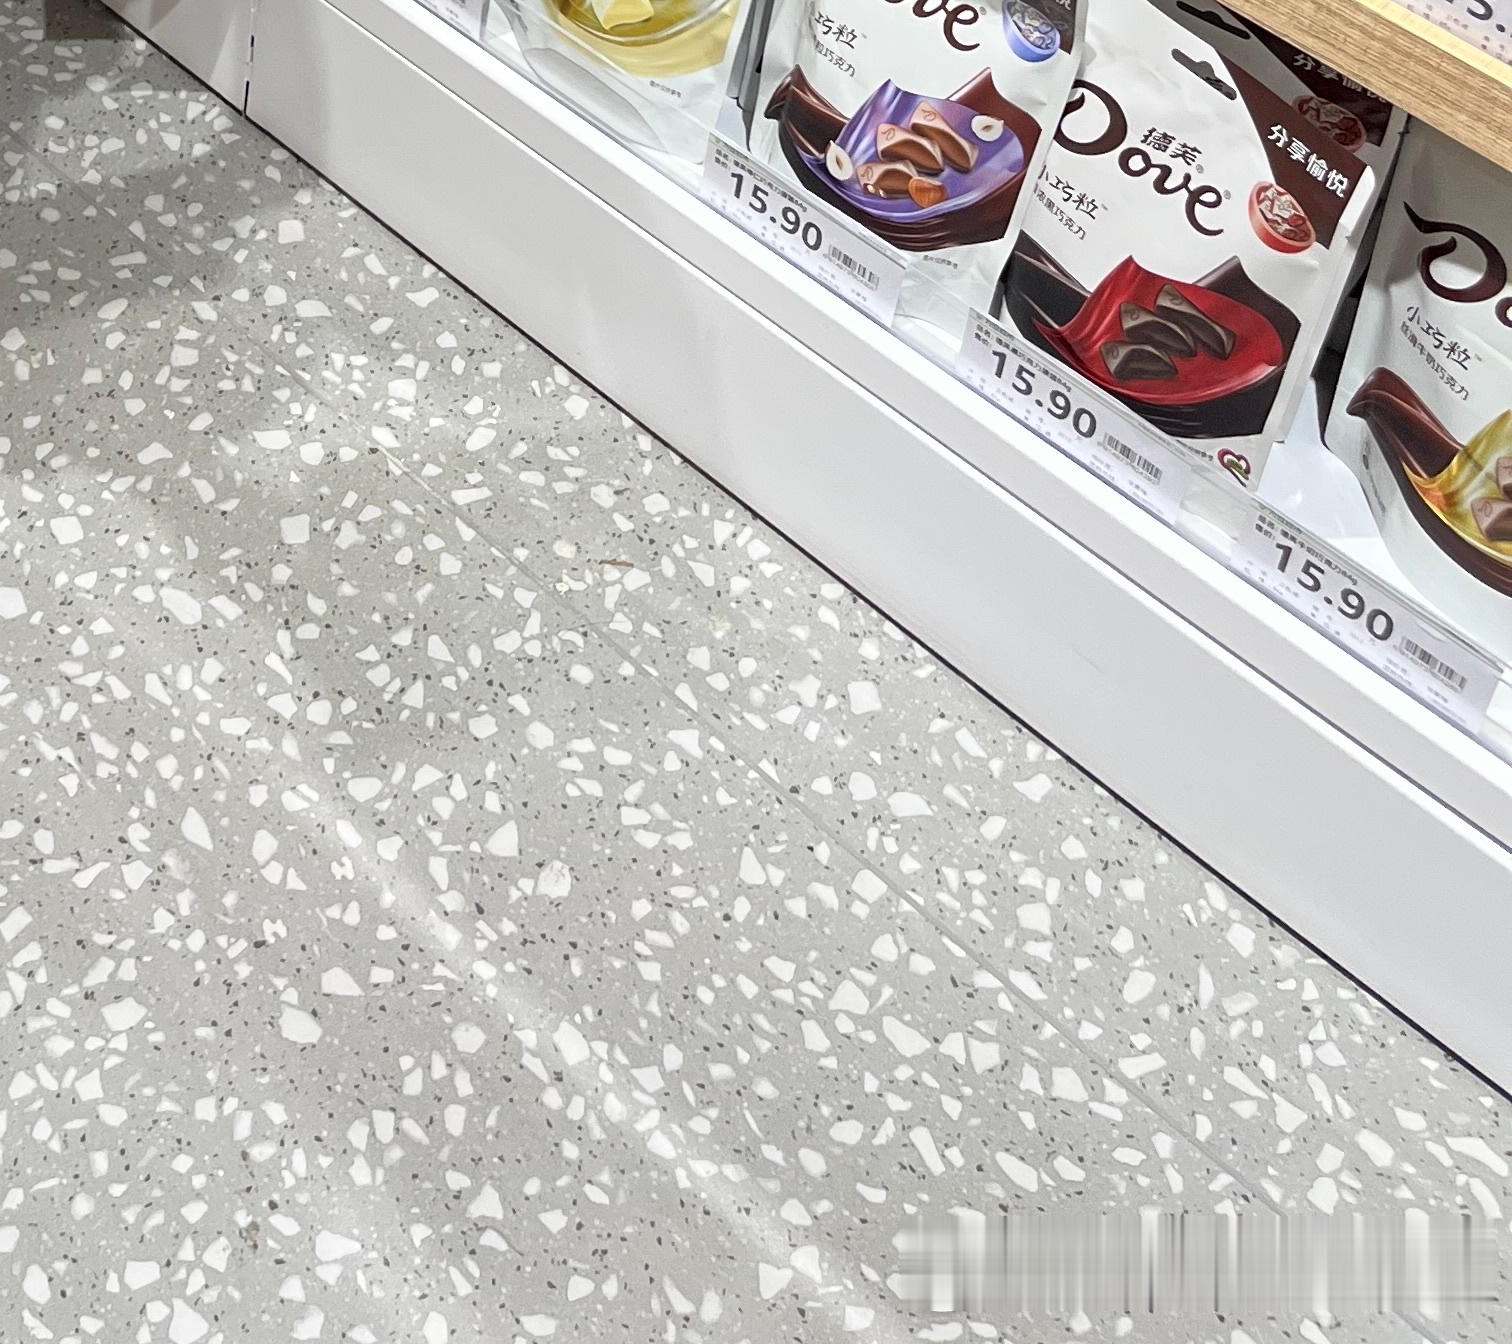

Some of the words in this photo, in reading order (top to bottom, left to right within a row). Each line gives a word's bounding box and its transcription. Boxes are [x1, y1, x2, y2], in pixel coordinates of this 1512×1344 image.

[1053, 79, 1225, 236] Dove
[1141, 127, 1202, 167] 德芙
[1267, 124, 1349, 199] 分享愉悦
[730, 172, 823, 252] 15.90
[1407, 304, 1472, 371] 小巧粒
[991, 348, 1098, 439] 15.90
[1270, 542, 1395, 644] 15.90
